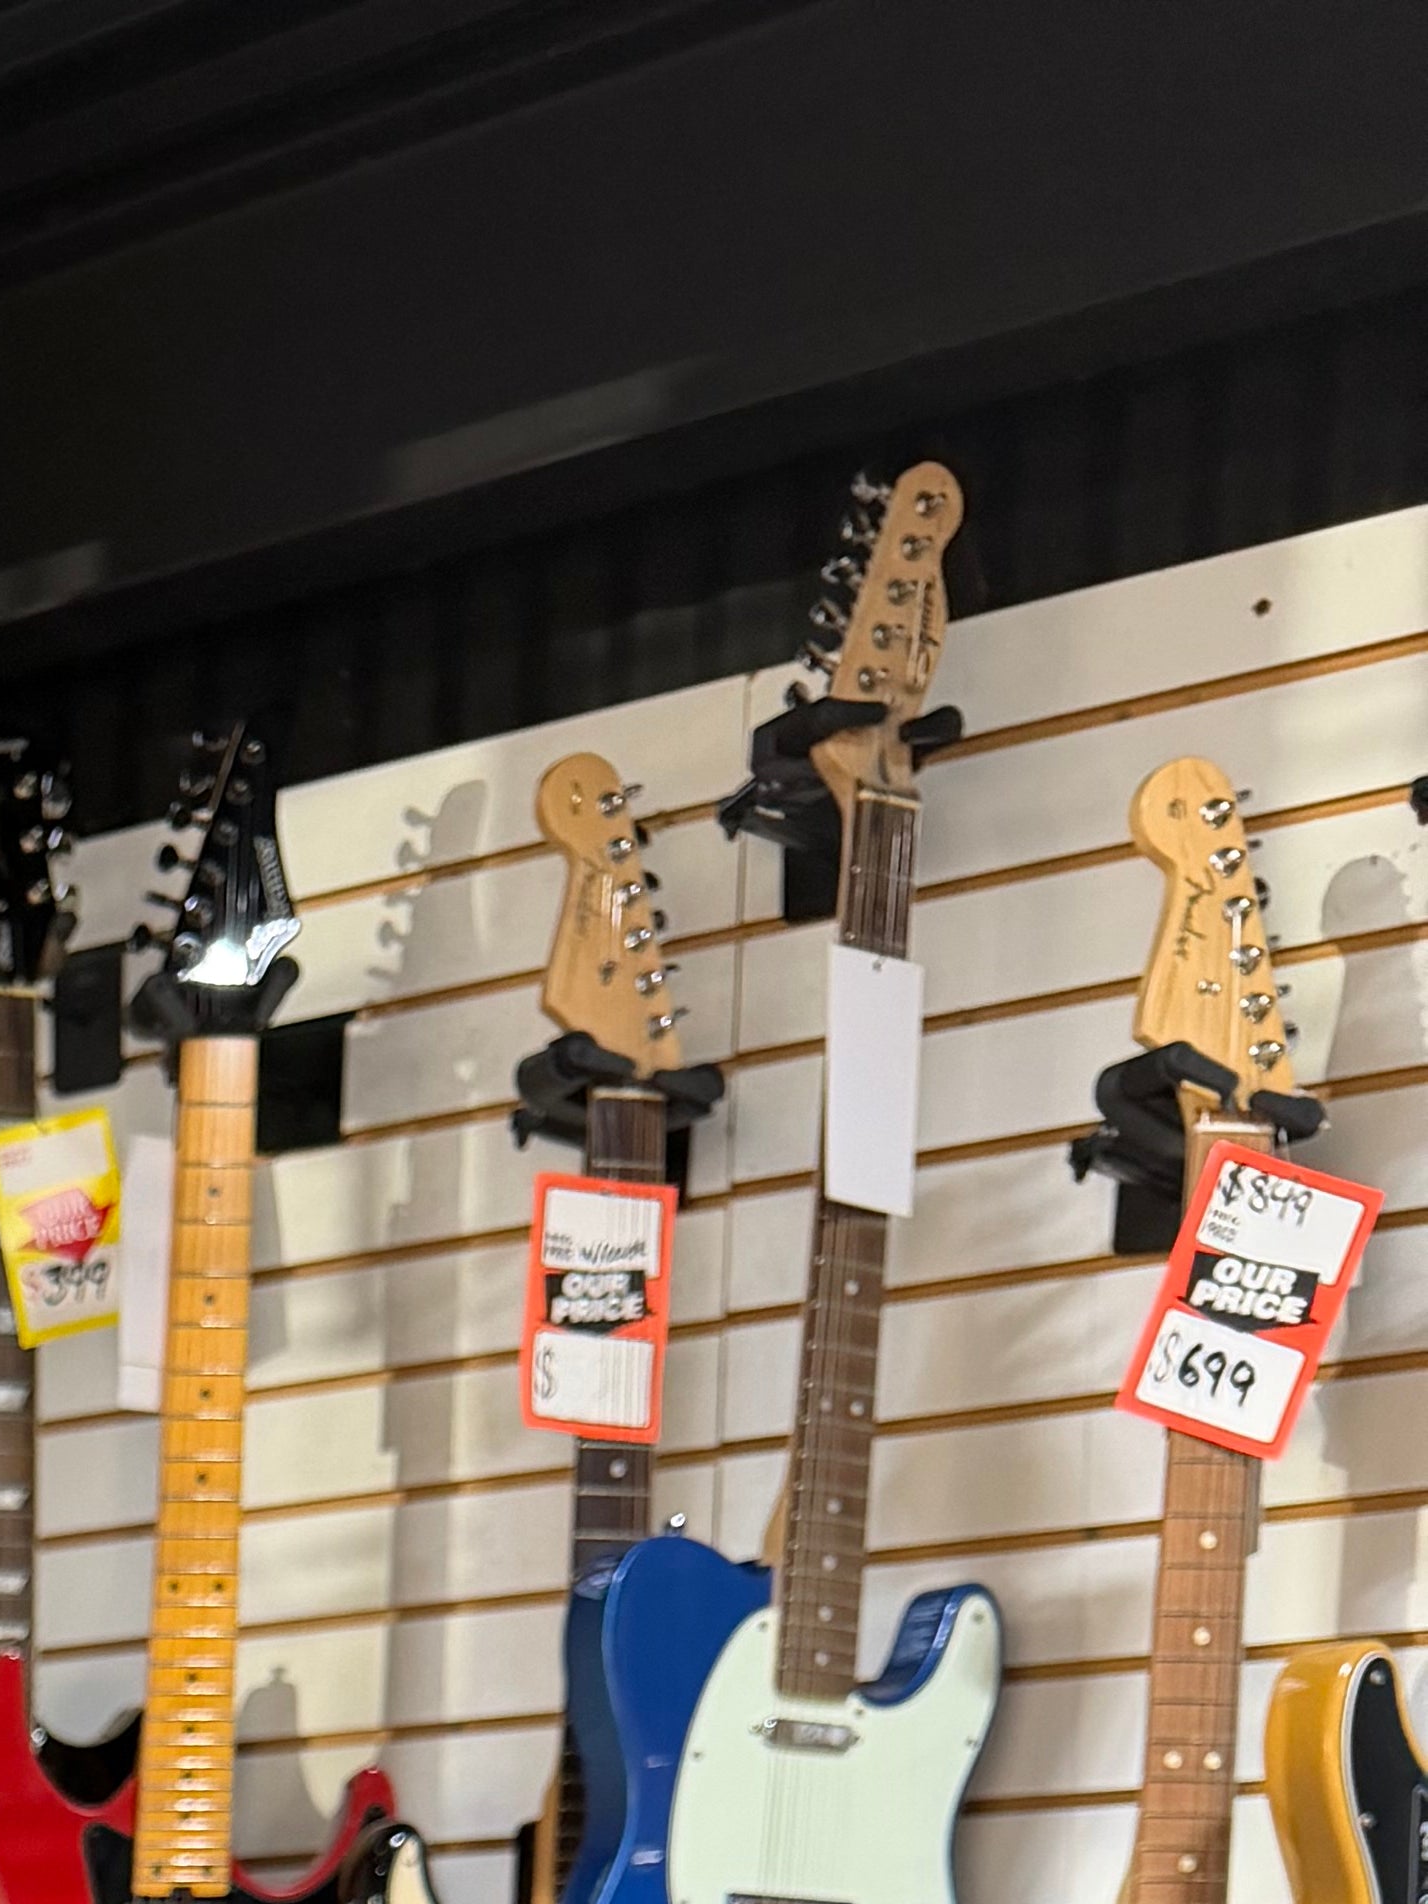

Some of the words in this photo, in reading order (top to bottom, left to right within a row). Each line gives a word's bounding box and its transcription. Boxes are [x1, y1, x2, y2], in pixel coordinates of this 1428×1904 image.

[1216, 1162, 1313, 1228] $849
[1212, 1257, 1297, 1296] OUR
[549, 1296, 646, 1326] PRICE
[1189, 1280, 1309, 1325] PRICE
[1148, 1331, 1255, 1407] $699
